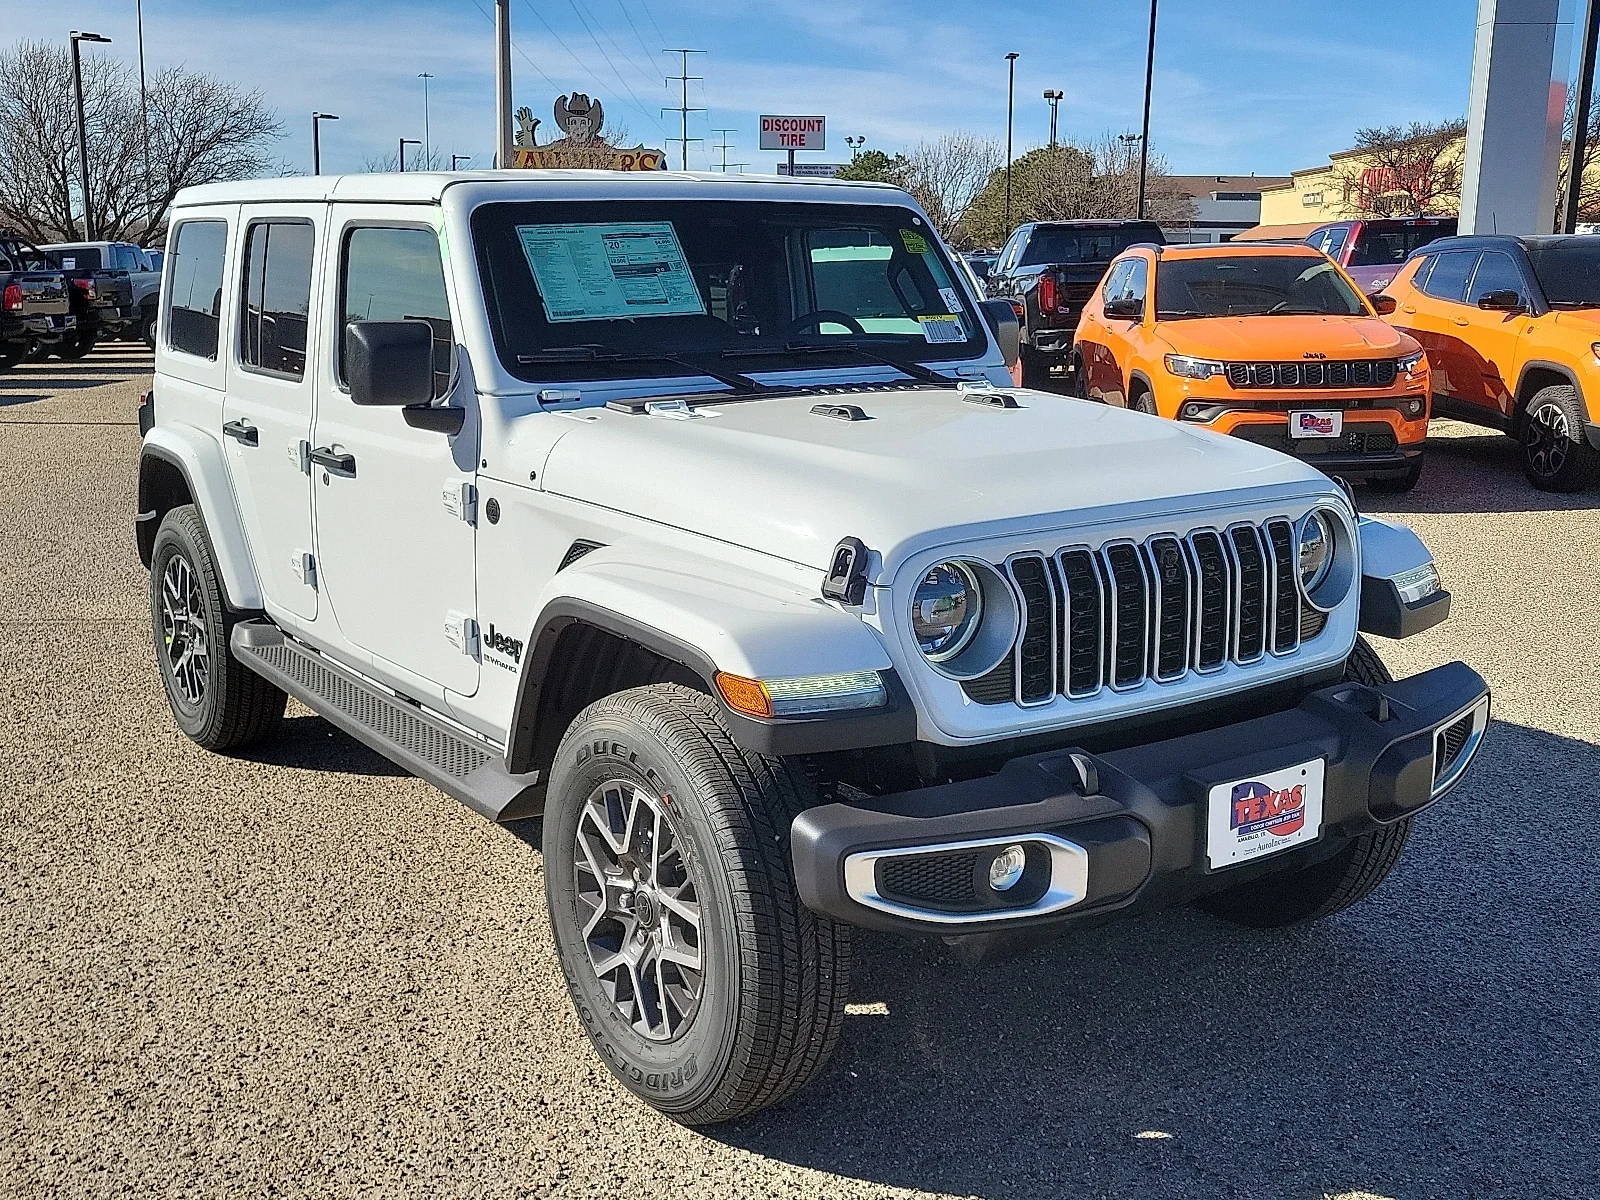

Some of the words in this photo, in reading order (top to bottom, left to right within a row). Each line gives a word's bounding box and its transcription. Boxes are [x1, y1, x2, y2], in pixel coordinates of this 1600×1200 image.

[763, 119, 822, 132] DISCOUNT
[780, 134, 805, 146] TIRE
[513, 151, 659, 171] AVEER'S
[608, 241, 620, 249] 20
[1302, 417, 1332, 426] TEXAS
[484, 622, 523, 665] Jeep
[1235, 784, 1303, 825] TEXAS
